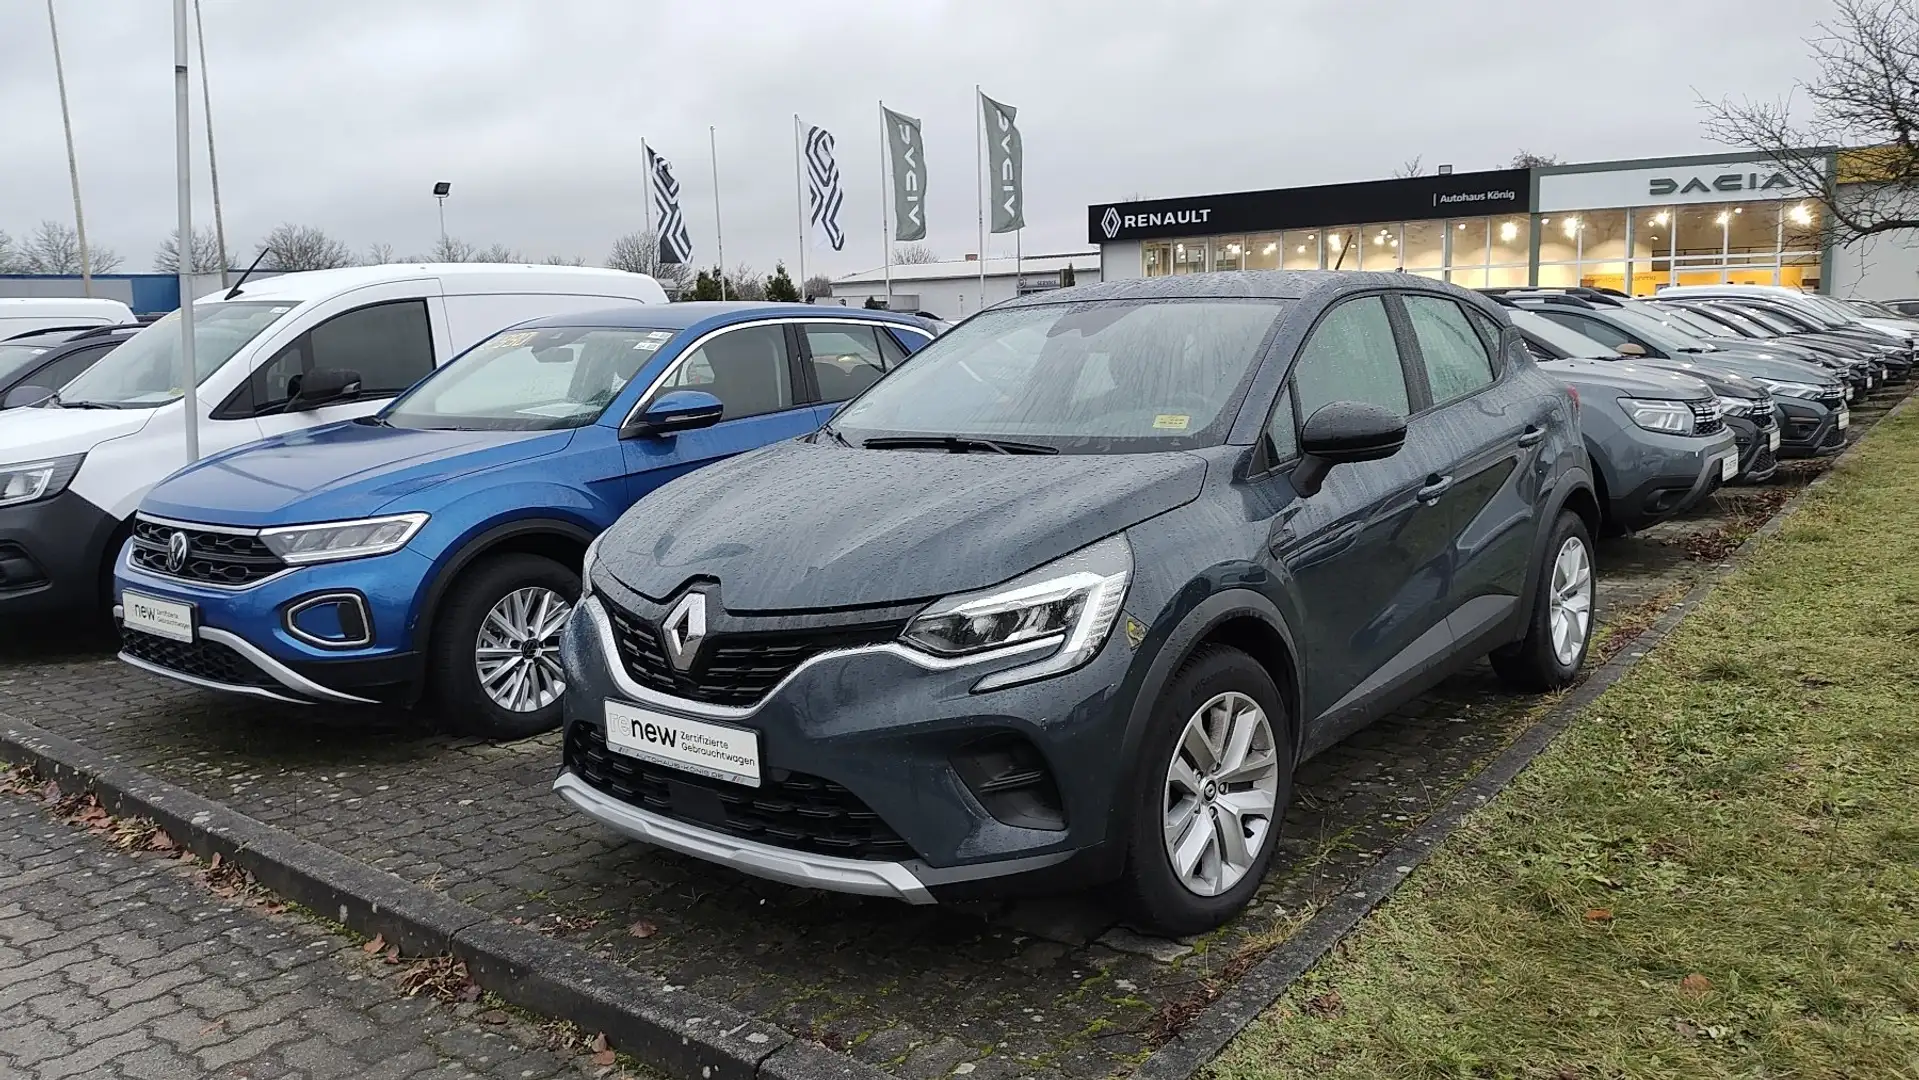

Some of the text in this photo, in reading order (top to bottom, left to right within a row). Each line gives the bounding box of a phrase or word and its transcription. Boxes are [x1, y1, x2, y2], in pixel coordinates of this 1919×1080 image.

[898, 124, 921, 226] DACIA
[1649, 171, 1794, 195] DACIA
[1440, 190, 1515, 203] Autohaus König
[1124, 209, 1211, 228] RENAULT
[680, 731, 729, 750] Zertifizierte
[681, 742, 755, 767] Gebrauchtwagen
